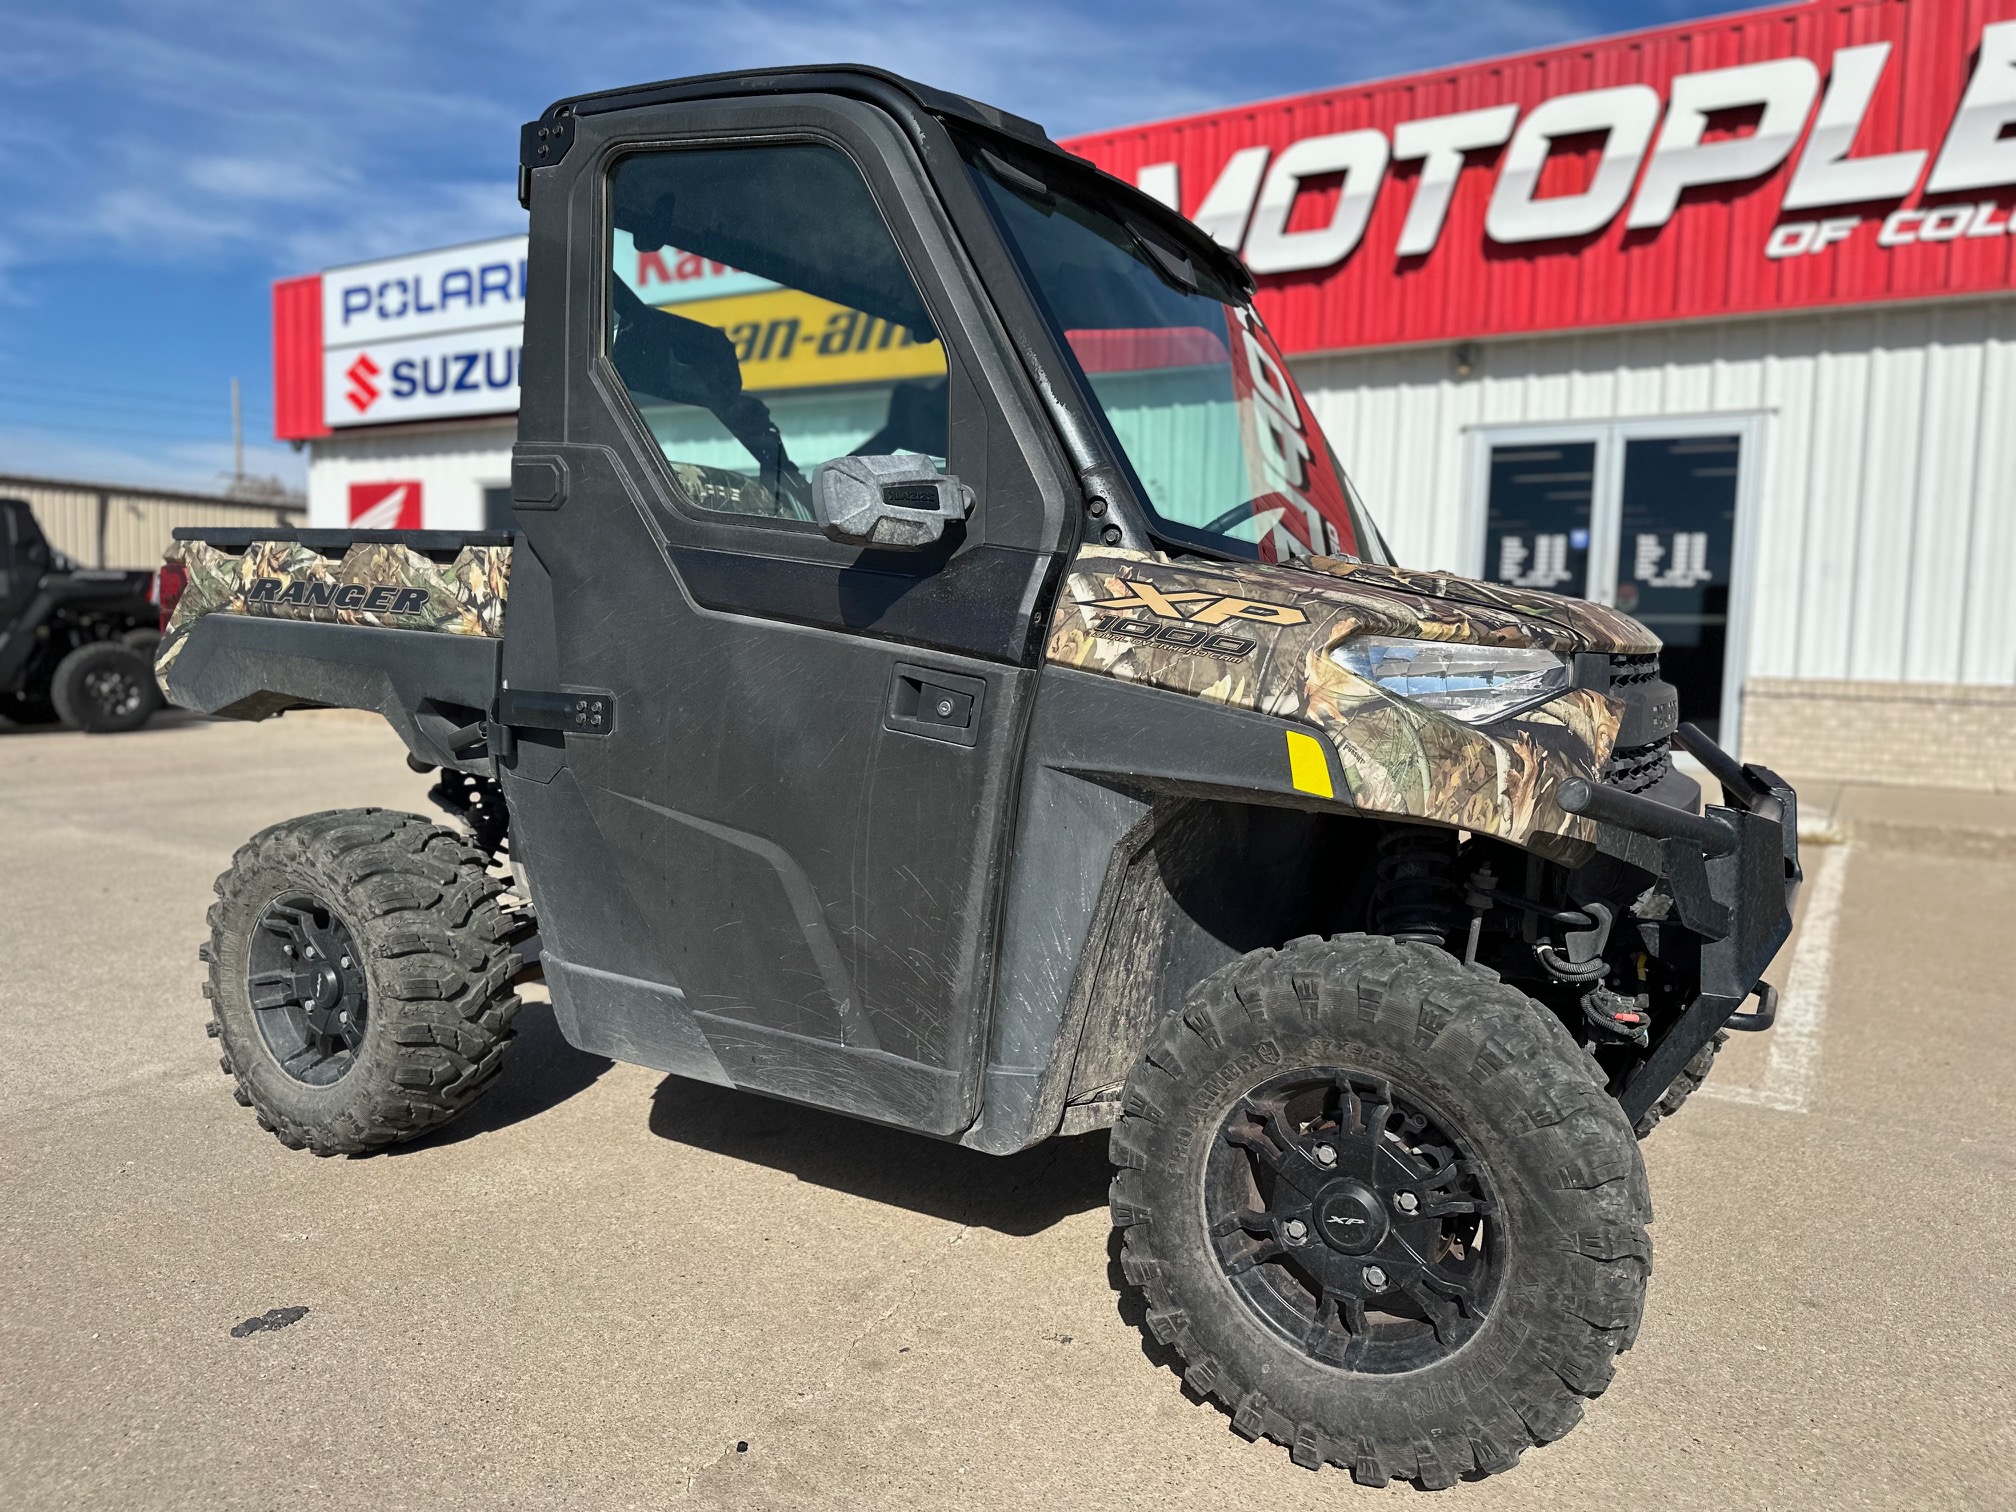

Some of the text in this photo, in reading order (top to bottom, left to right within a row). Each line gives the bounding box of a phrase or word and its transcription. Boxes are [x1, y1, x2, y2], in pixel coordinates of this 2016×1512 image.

[1764, 200, 2016, 258] OF COL
[391, 346, 523, 398] SUZU
[249, 577, 430, 616] RANGER
[1075, 577, 1311, 627] XP
[1093, 615, 1257, 657] 1000
[1130, 637, 1208, 658] OVERHEAD
[1326, 1215, 1365, 1225] XP
